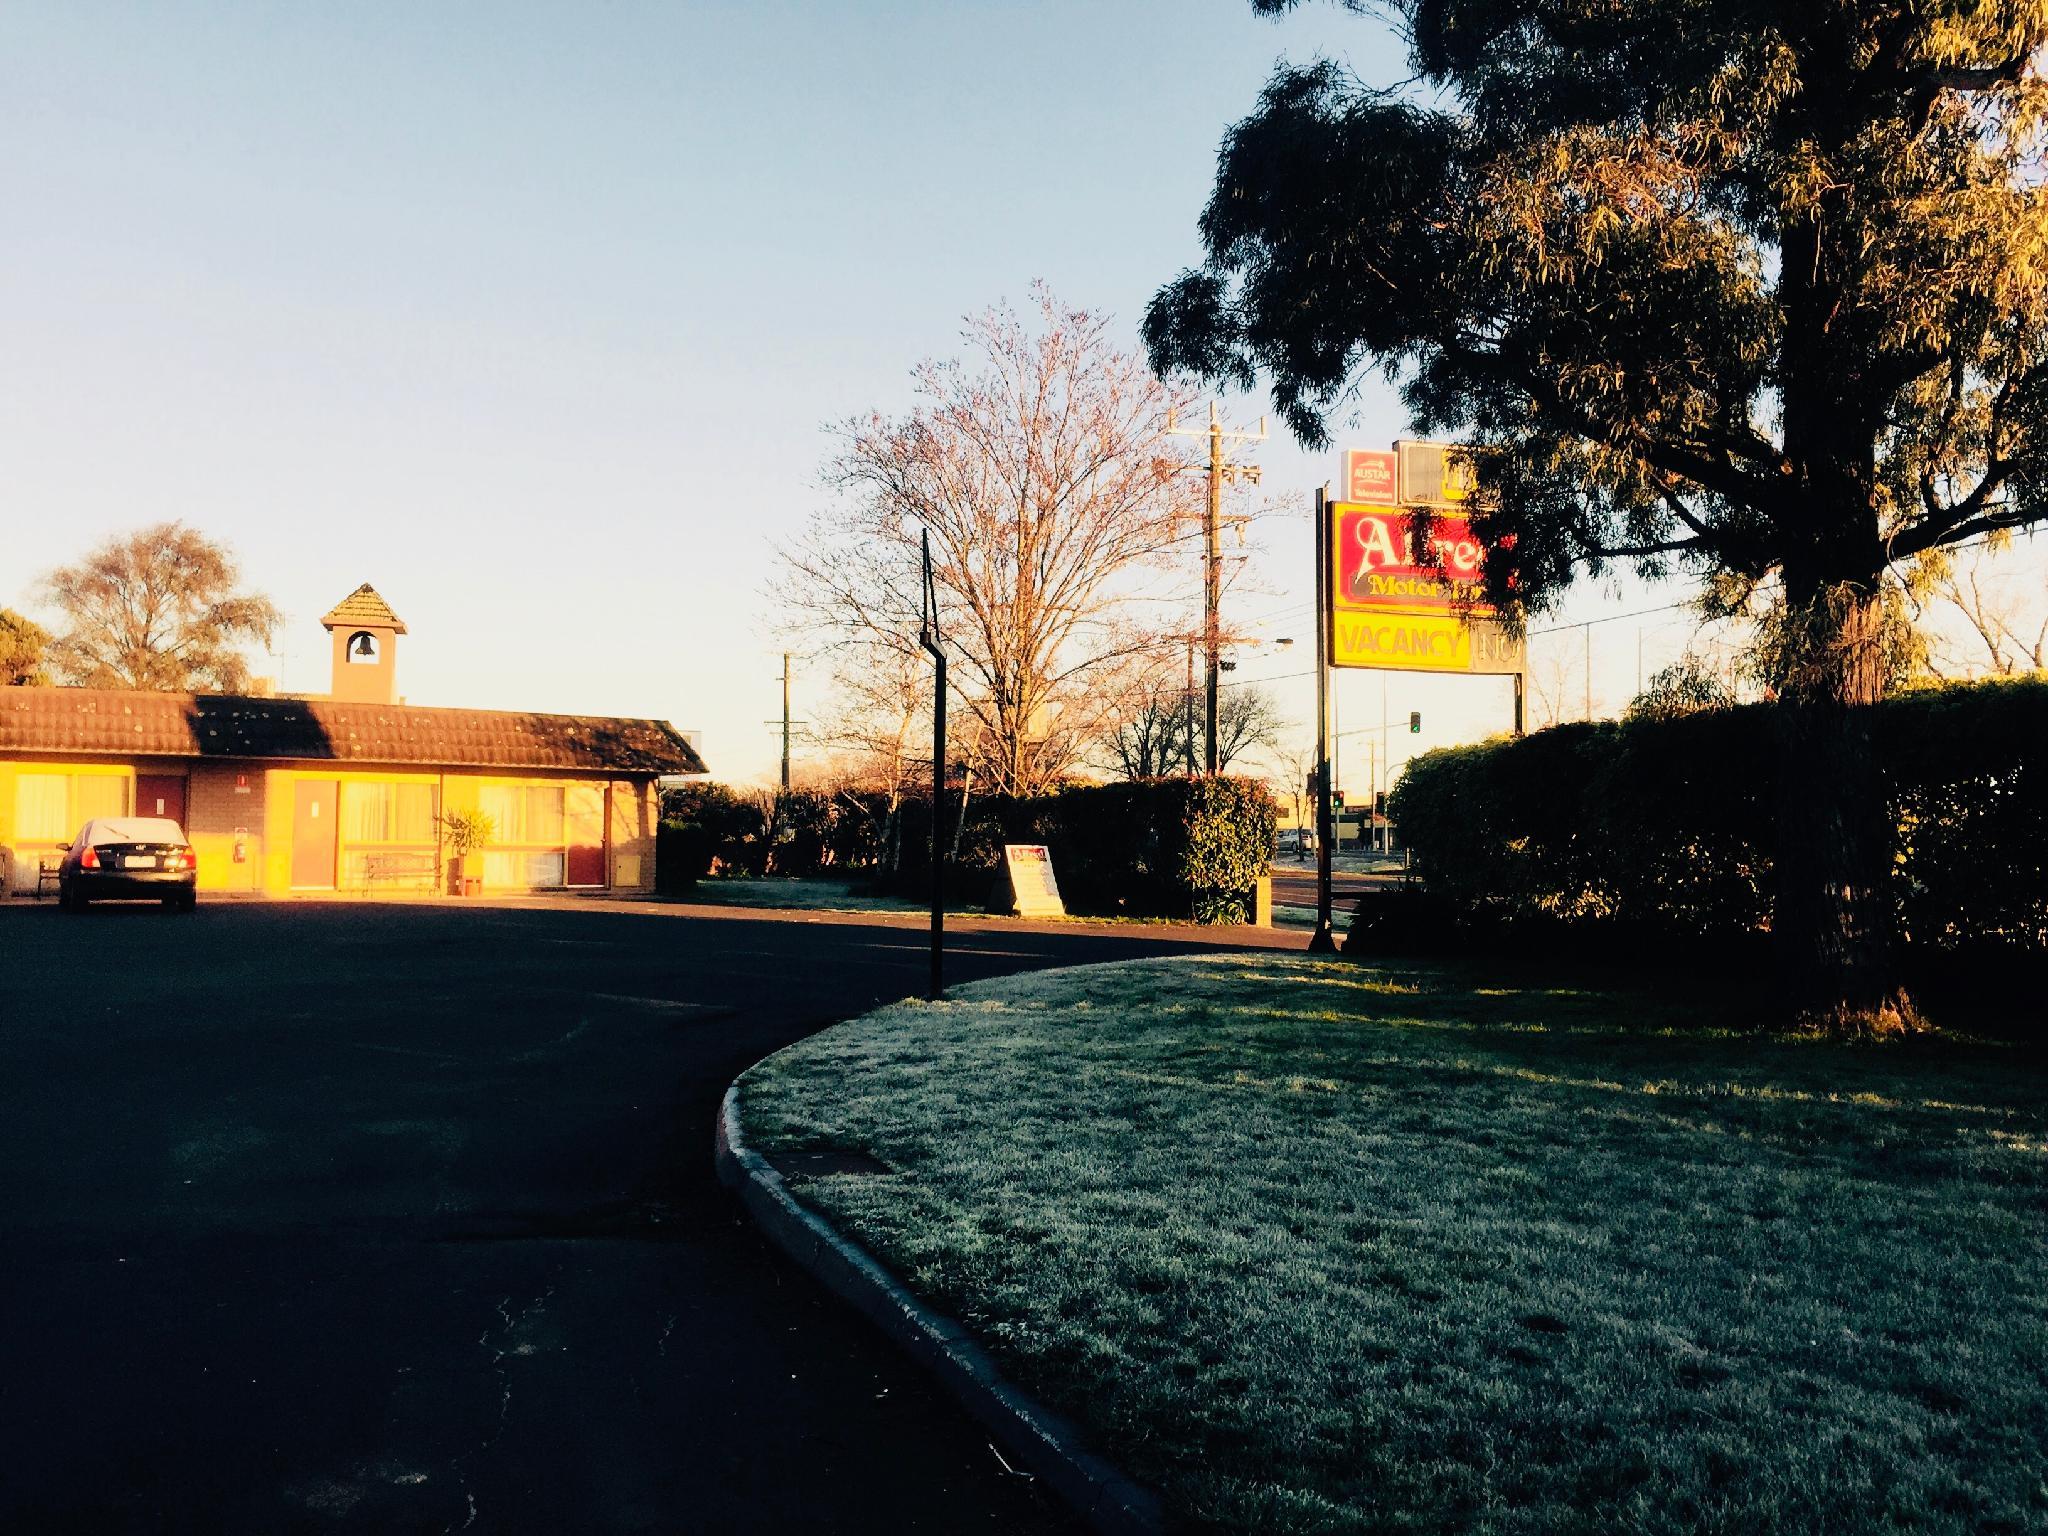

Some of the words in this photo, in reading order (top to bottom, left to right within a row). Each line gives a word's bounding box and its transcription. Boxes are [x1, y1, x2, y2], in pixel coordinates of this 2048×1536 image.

[1354, 468, 1391, 481] AUSTAR
[1355, 488, 1393, 499] Television
[1368, 574, 1440, 597] Motor
[1339, 624, 1463, 658] VACANCY
